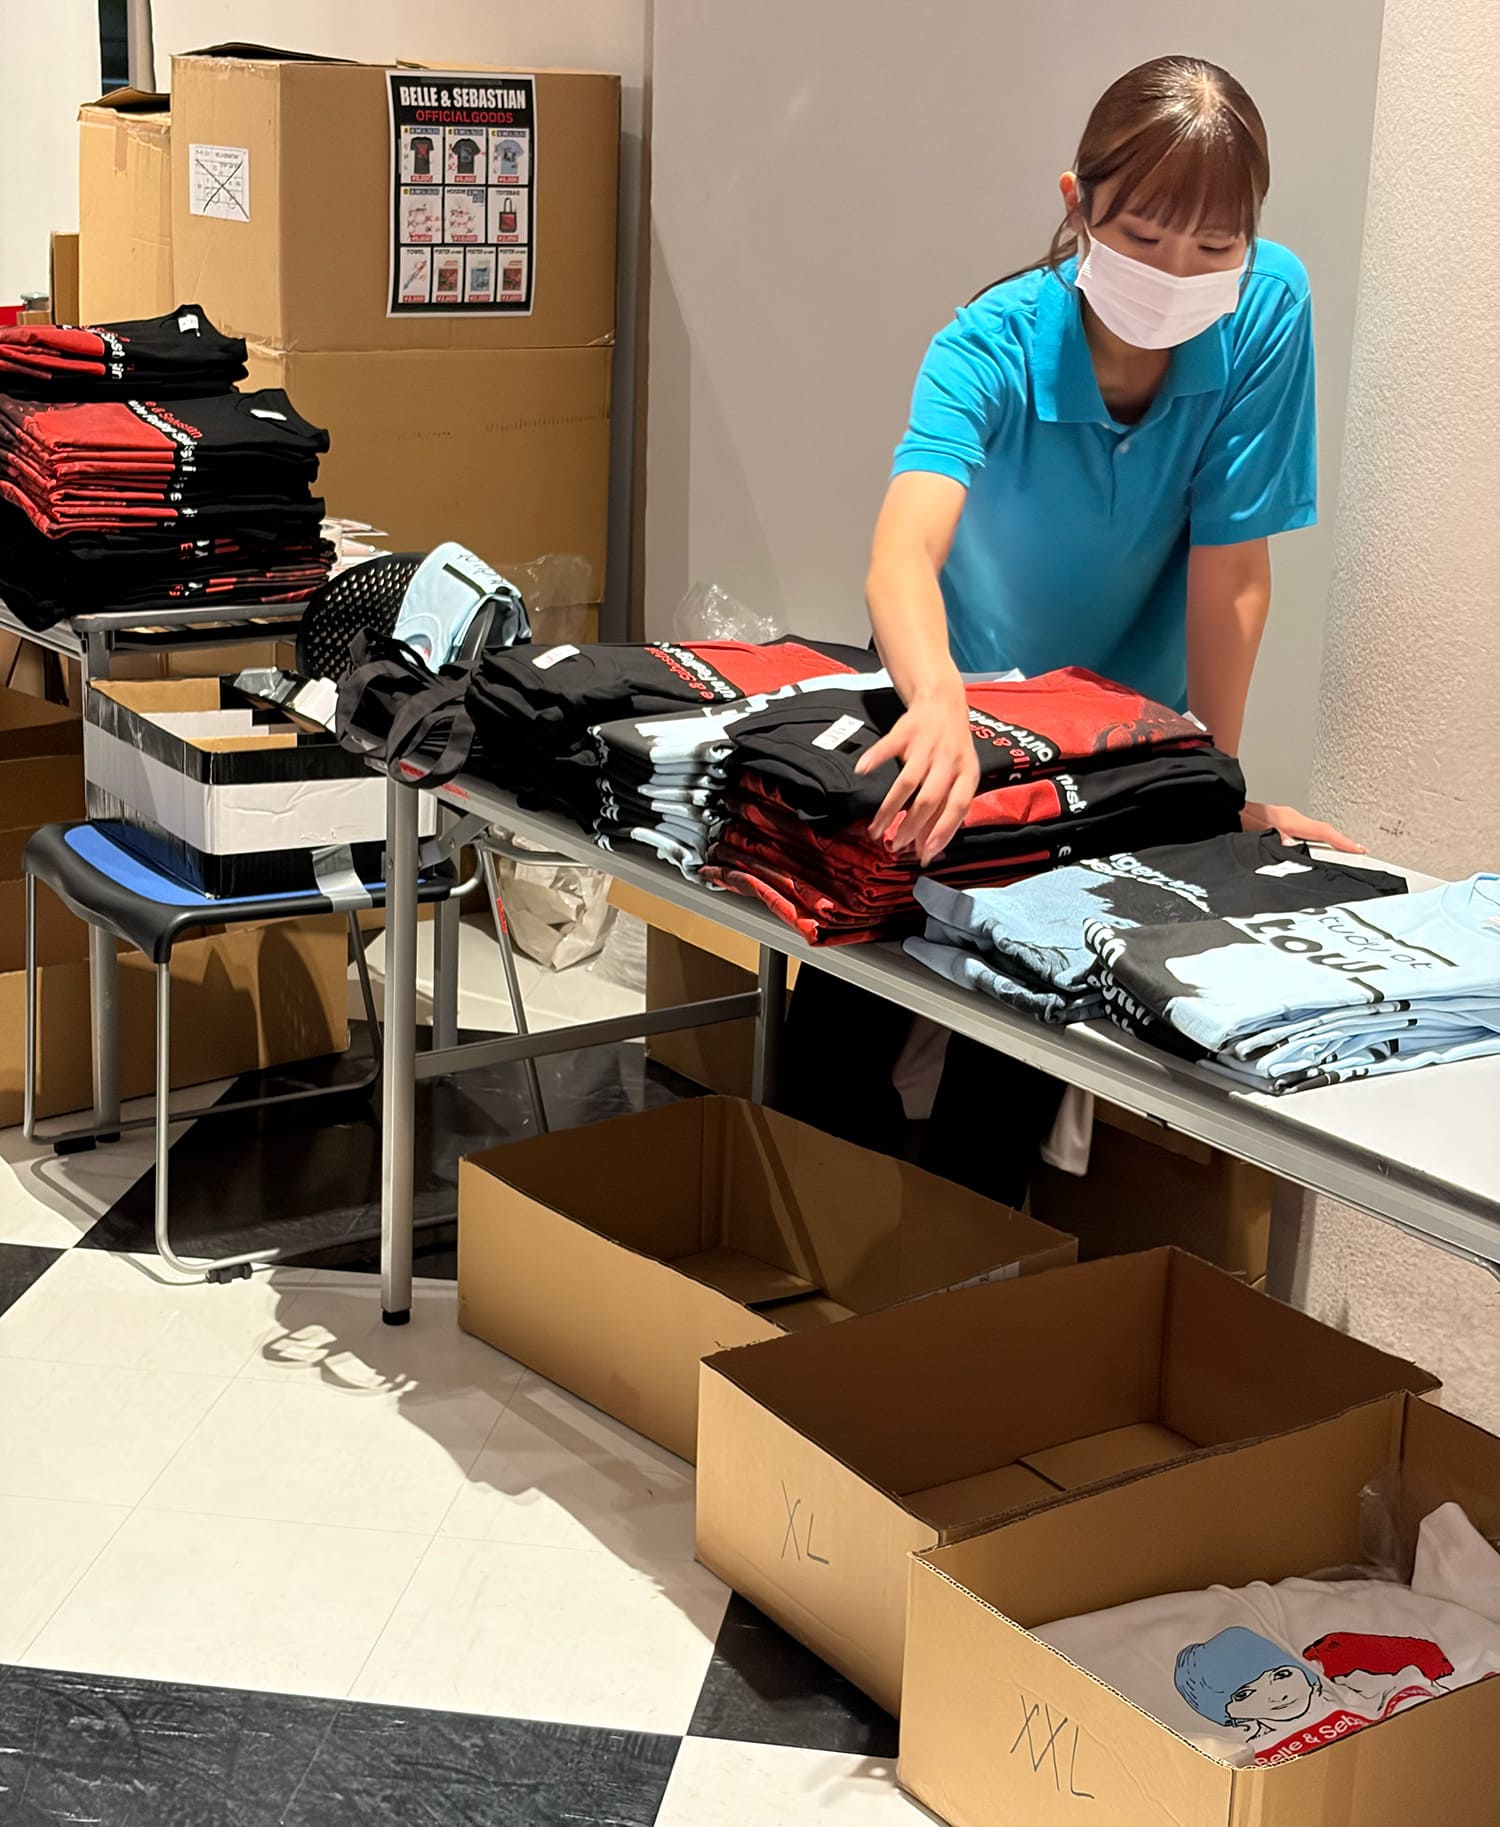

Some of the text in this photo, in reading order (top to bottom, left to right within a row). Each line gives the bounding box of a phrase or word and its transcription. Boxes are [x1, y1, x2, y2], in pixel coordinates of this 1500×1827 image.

[400, 86, 526, 109] BELLE & SEBASTIAN
[780, 1479, 830, 1565] XL
[1009, 1694, 1096, 1801] XXL
[1303, 1731, 1321, 1745] &
